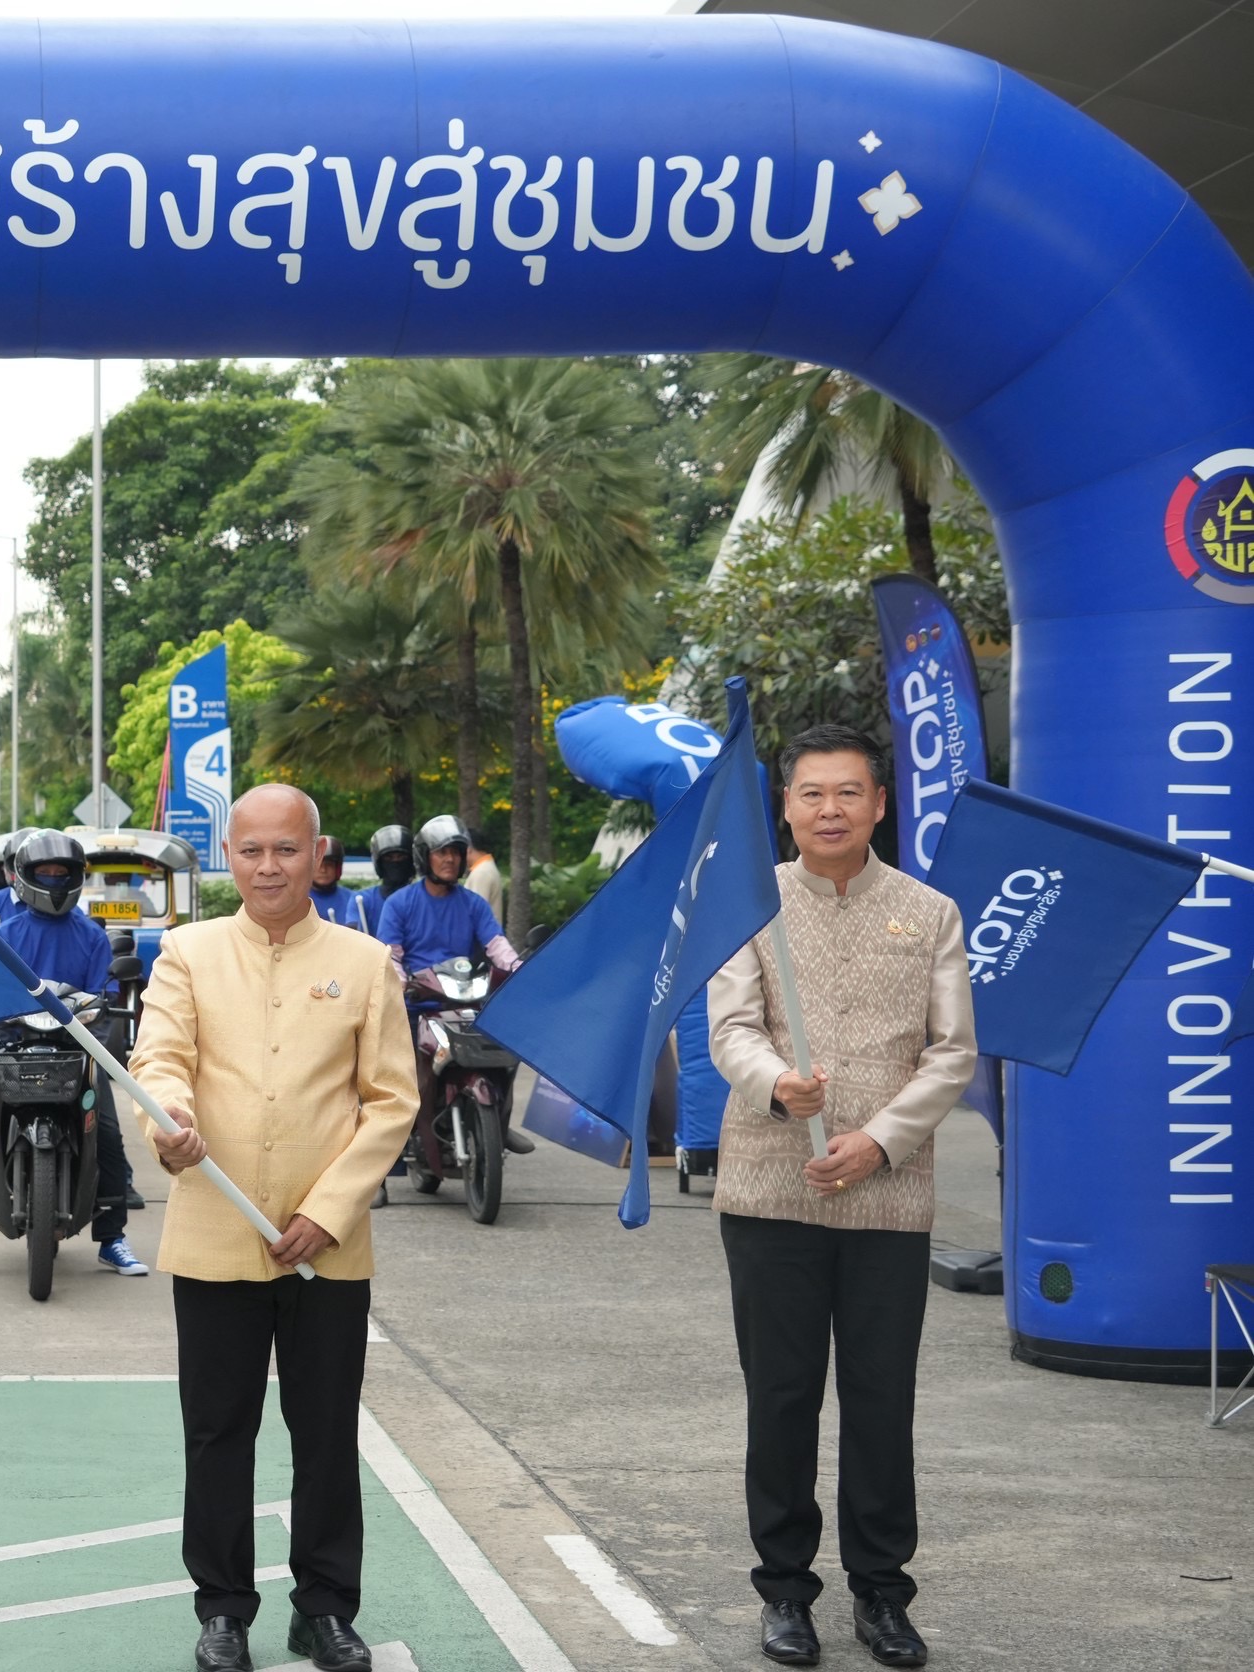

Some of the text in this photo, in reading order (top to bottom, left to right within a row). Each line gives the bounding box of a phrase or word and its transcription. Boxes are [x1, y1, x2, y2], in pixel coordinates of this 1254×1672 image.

[171, 685, 198, 719] B
[205, 745, 227, 777] 4
[113, 902, 138, 914] 1854
